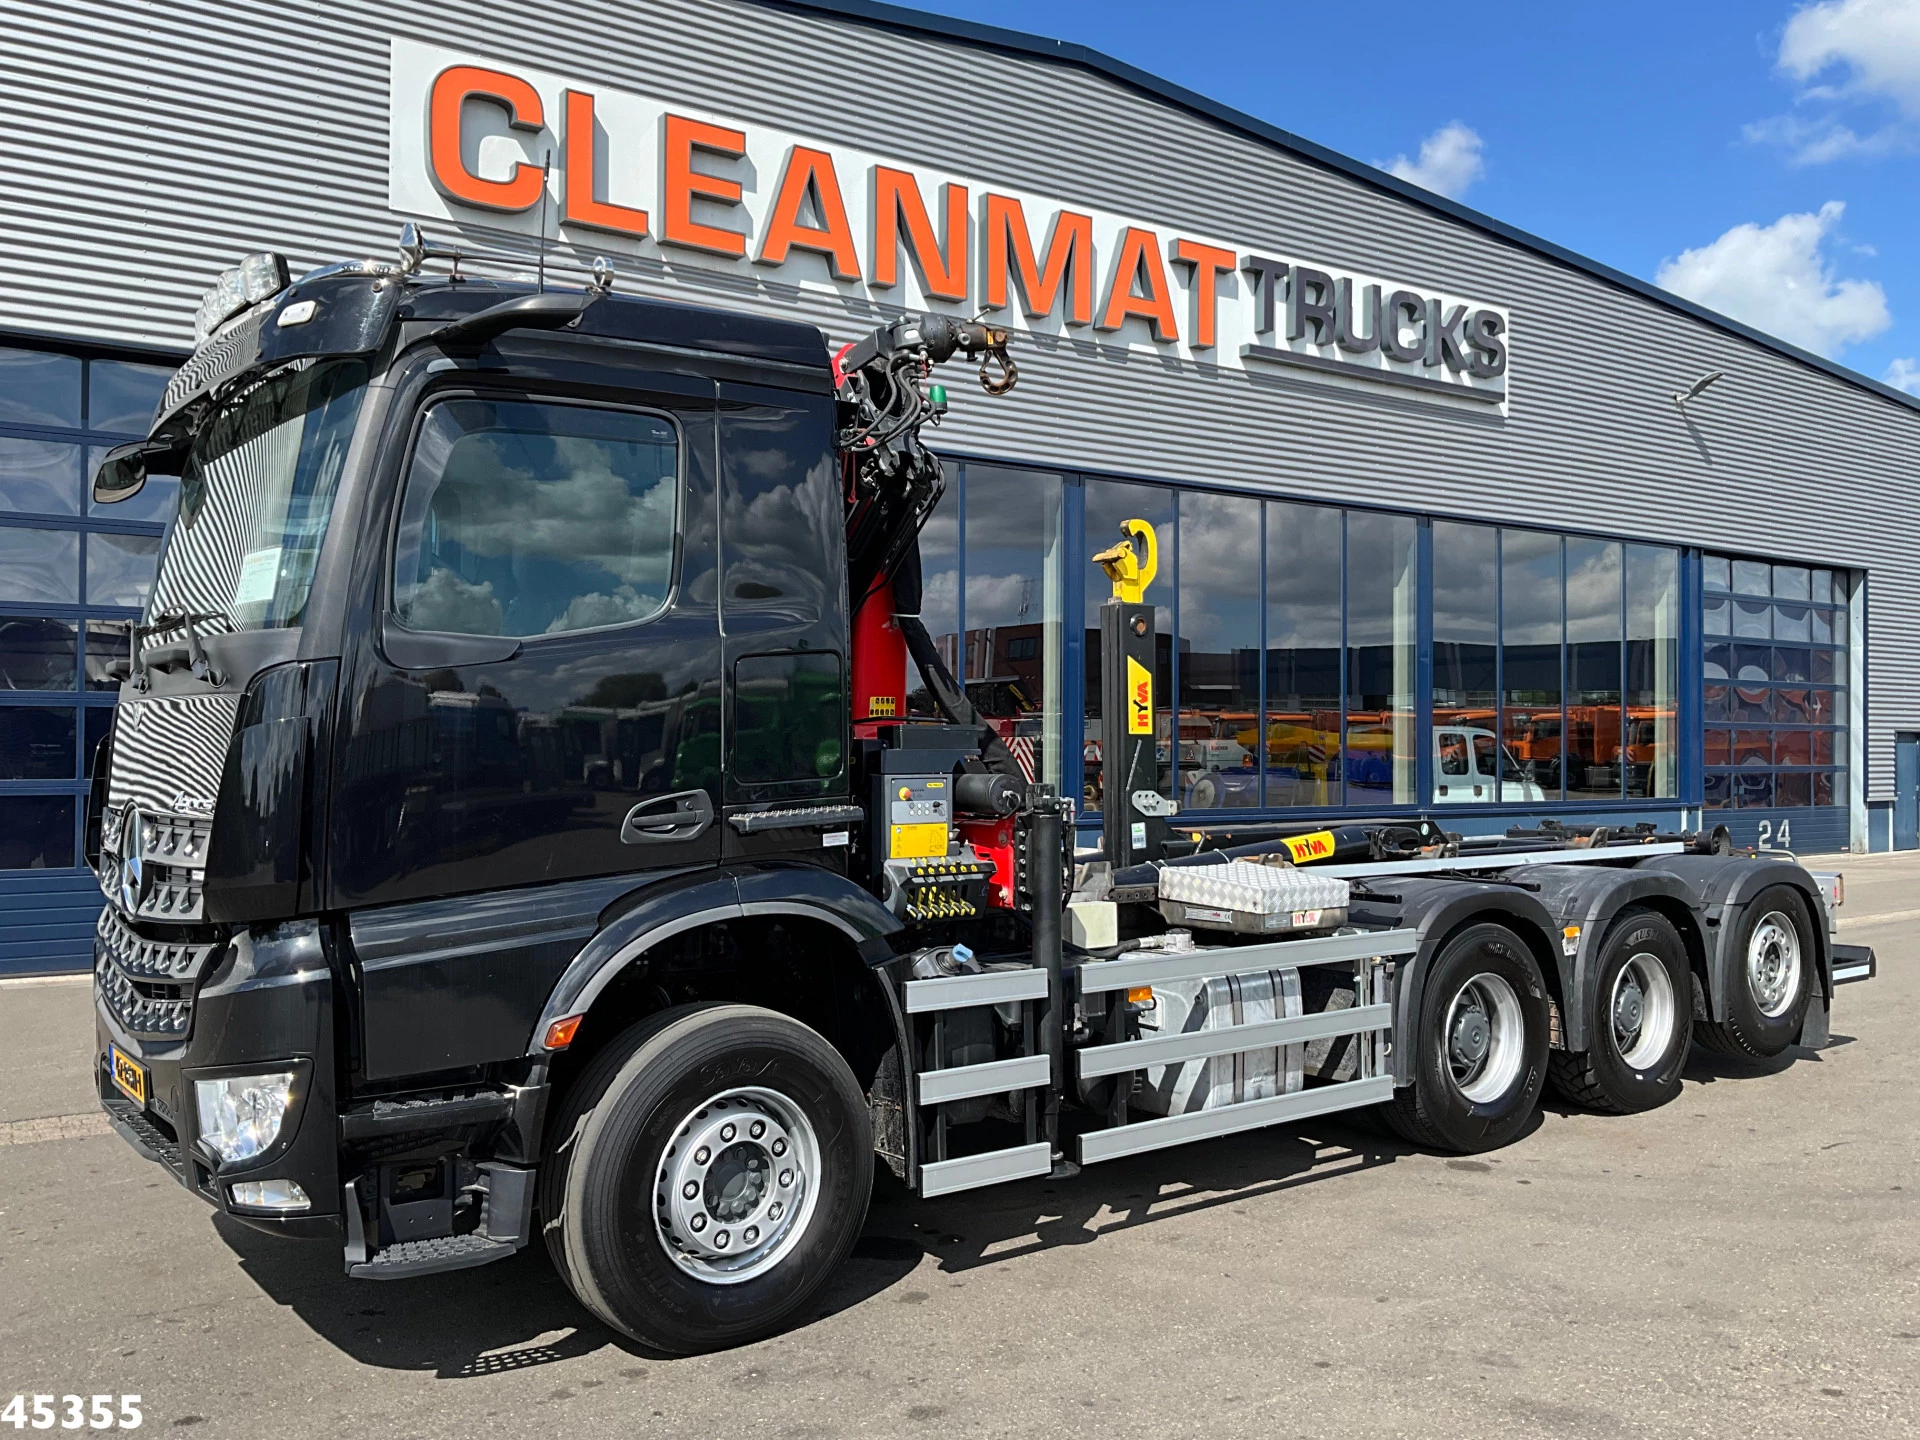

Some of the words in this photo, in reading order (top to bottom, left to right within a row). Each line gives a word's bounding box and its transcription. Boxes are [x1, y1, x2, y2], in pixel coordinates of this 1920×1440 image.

[427, 64, 1236, 349] CLEANMAT
[1241, 255, 1506, 378] TRUCKS
[1133, 681, 1149, 727] HYVA
[1293, 838, 1328, 859] HYVA
[1758, 819, 1791, 849] 24
